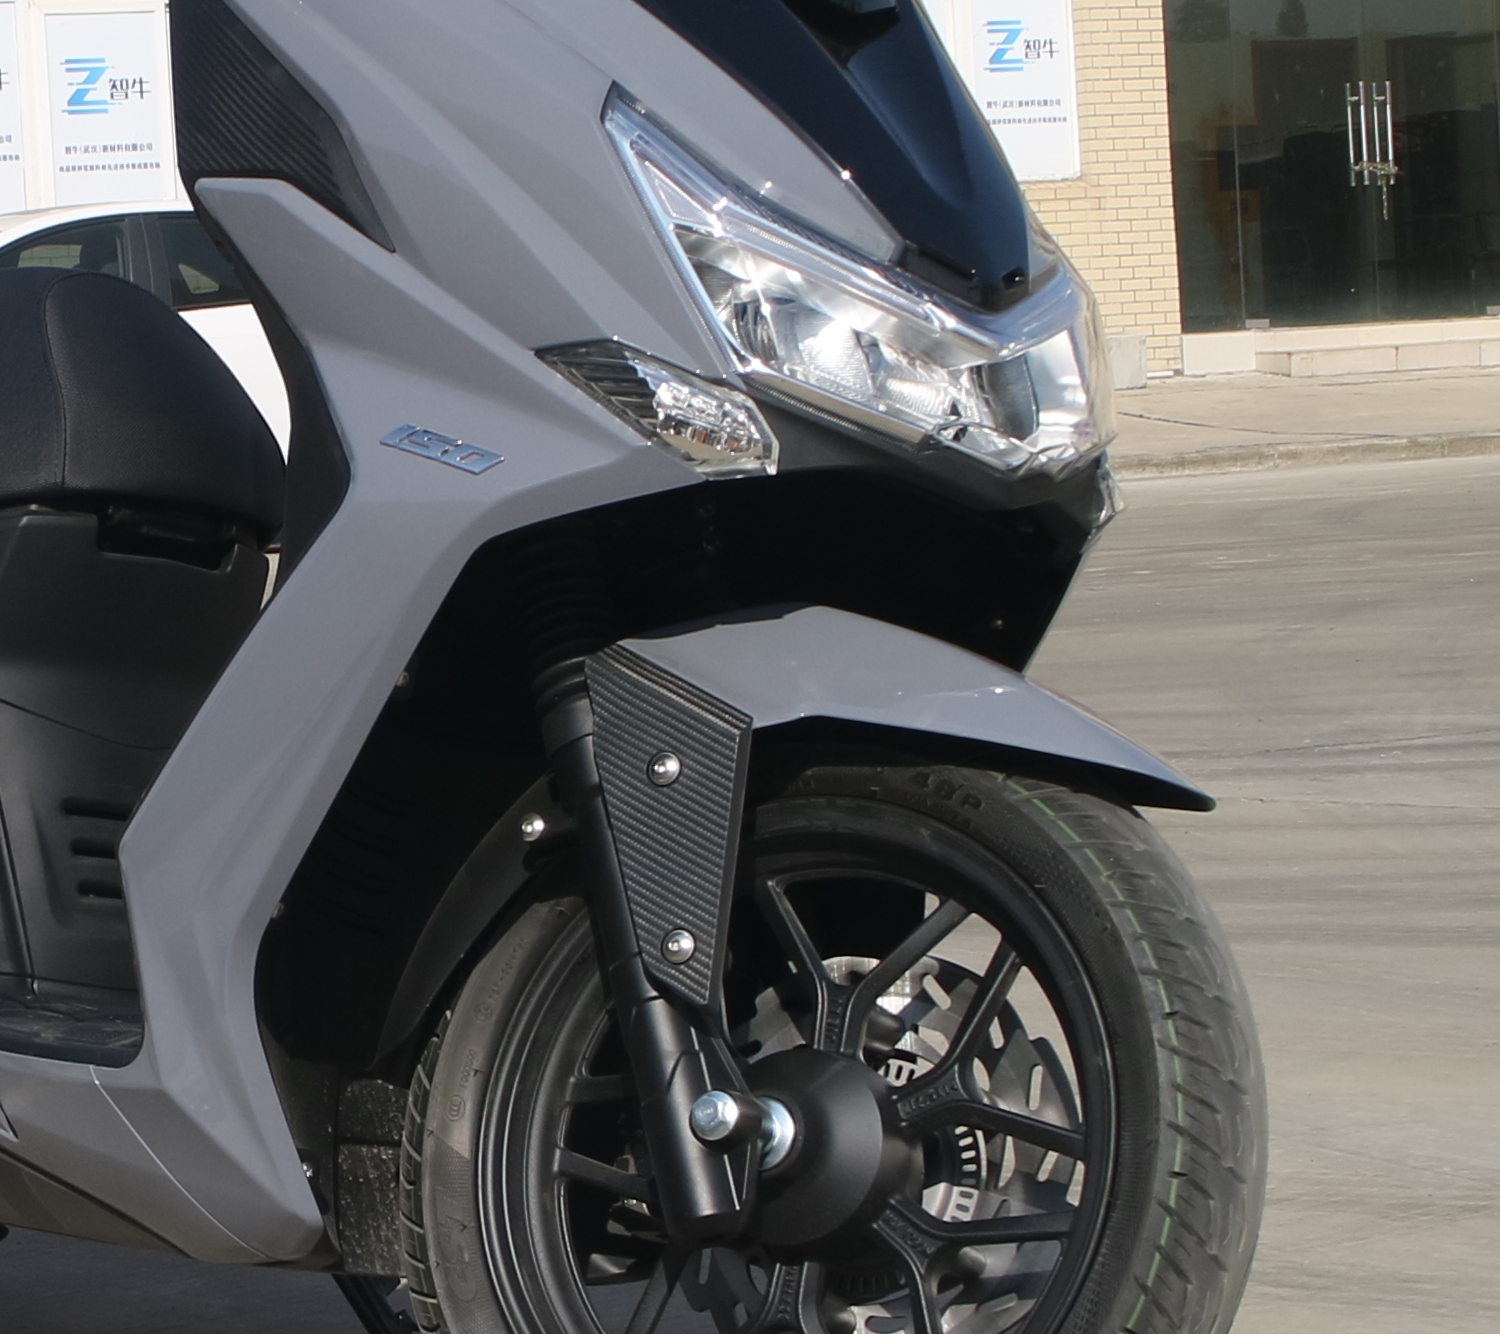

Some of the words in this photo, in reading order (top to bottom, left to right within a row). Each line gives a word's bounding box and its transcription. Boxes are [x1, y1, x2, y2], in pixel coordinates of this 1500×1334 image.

[1024, 38, 1060, 59] 智牛
[108, 77, 151, 101] 智牛
[379, 424, 505, 475] 150
